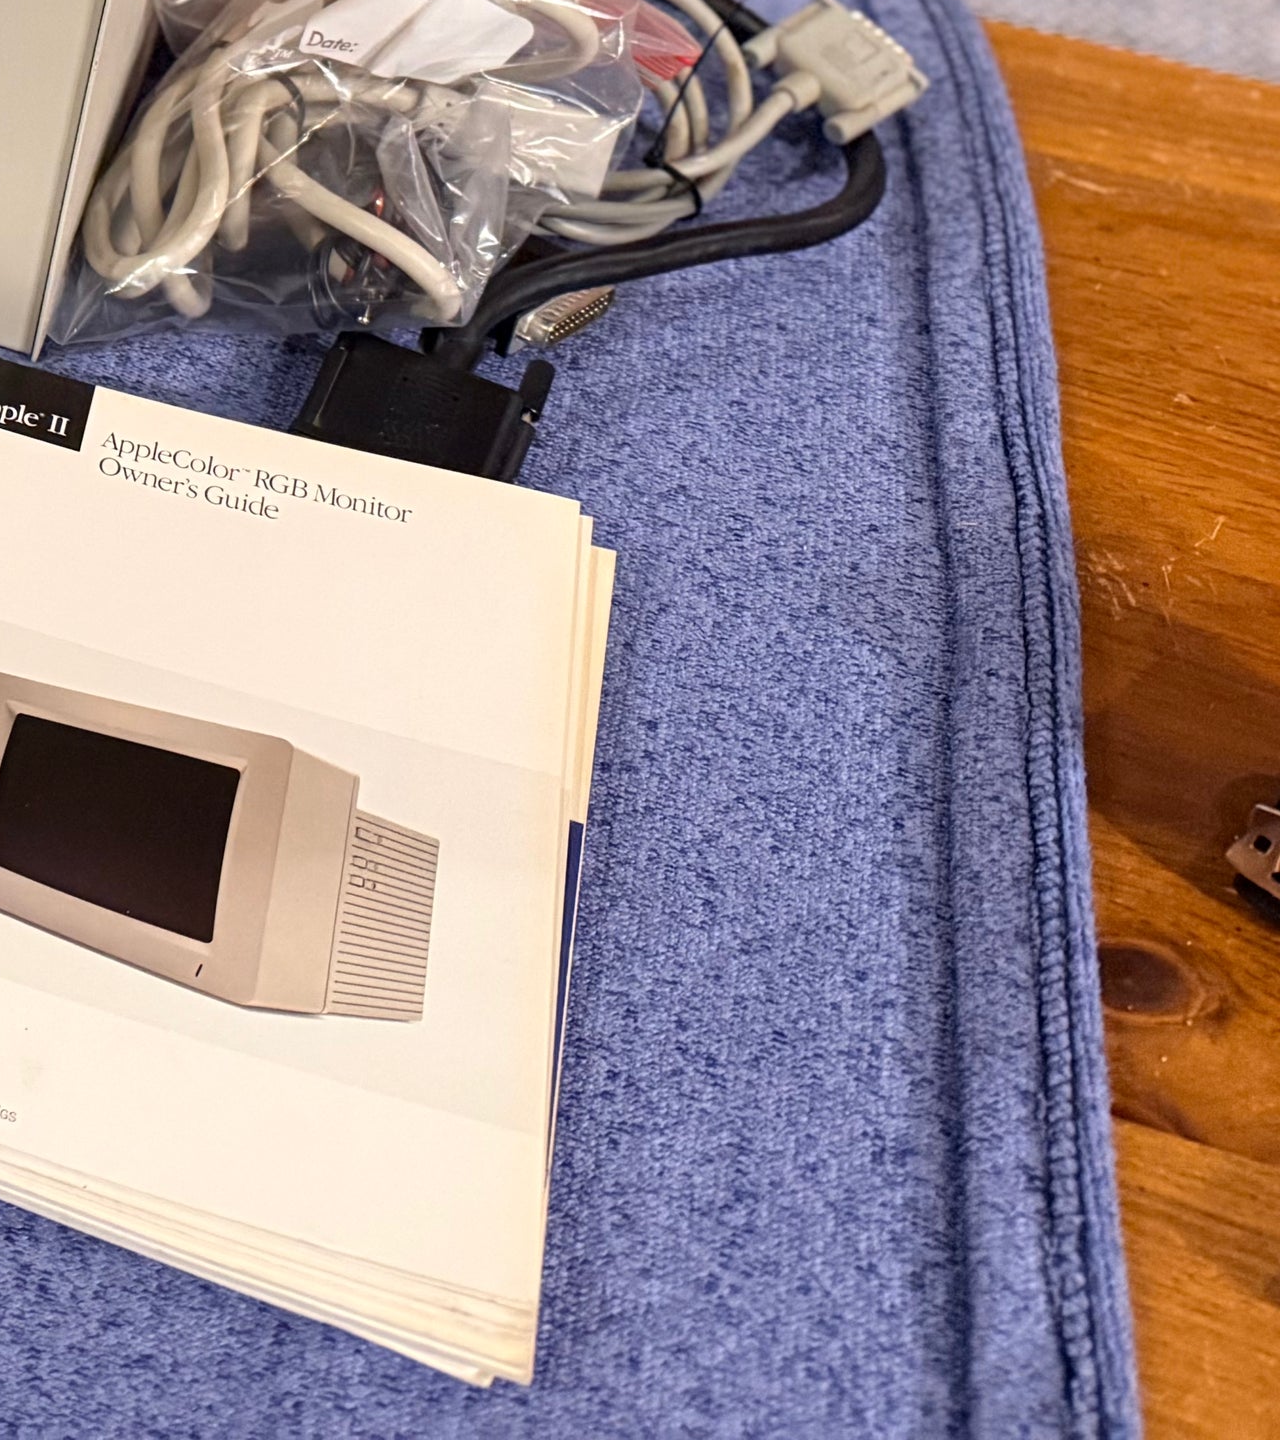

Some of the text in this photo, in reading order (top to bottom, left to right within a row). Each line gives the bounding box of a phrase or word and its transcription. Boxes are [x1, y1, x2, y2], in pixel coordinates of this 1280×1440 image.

[305, 30, 358, 54] Date:
[46, 413, 71, 437] II
[98, 457, 280, 521] Owner's Guide
[253, 468, 309, 499] RGB
[313, 484, 414, 523] Monitor
